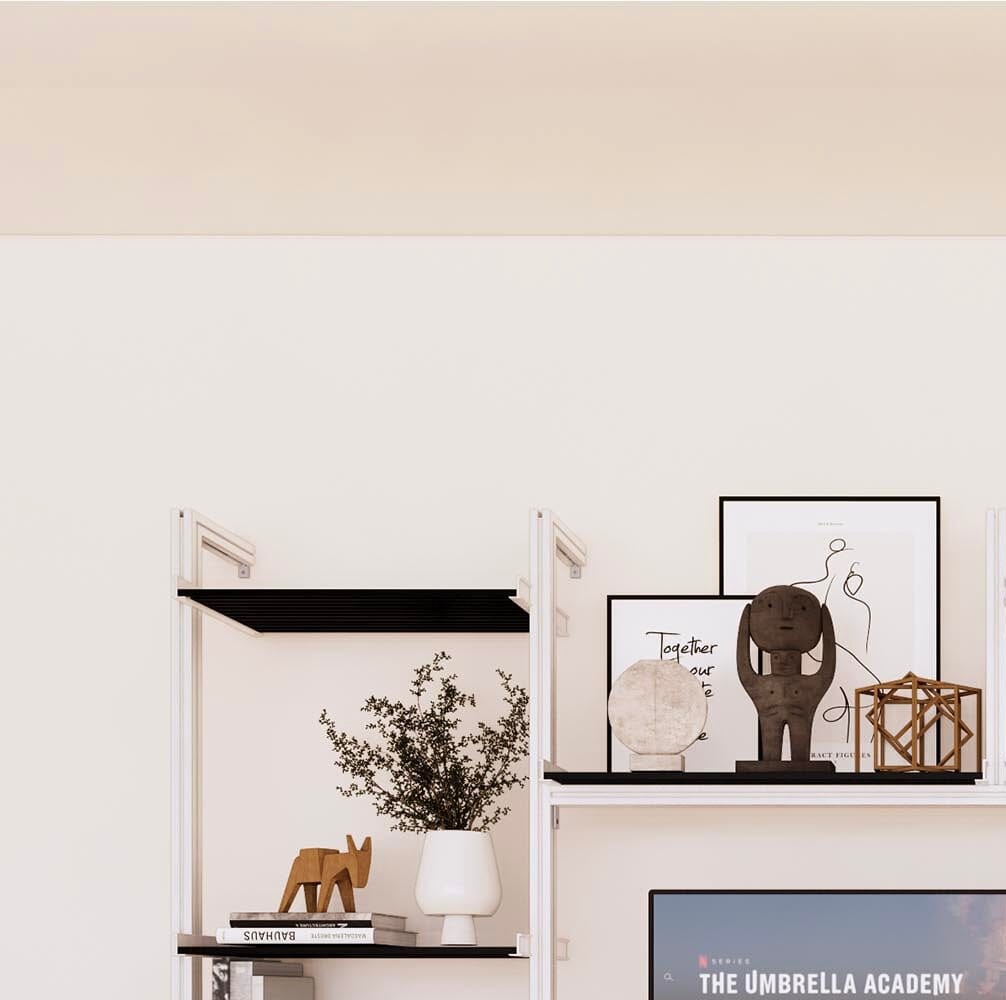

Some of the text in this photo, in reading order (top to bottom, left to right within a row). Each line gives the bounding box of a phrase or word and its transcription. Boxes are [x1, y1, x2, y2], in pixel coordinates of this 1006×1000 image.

[646, 632, 718, 664] Together
[243, 931, 296, 941] BAUHAUS
[699, 969, 964, 996] THE UMBRELLA ACADEMY
